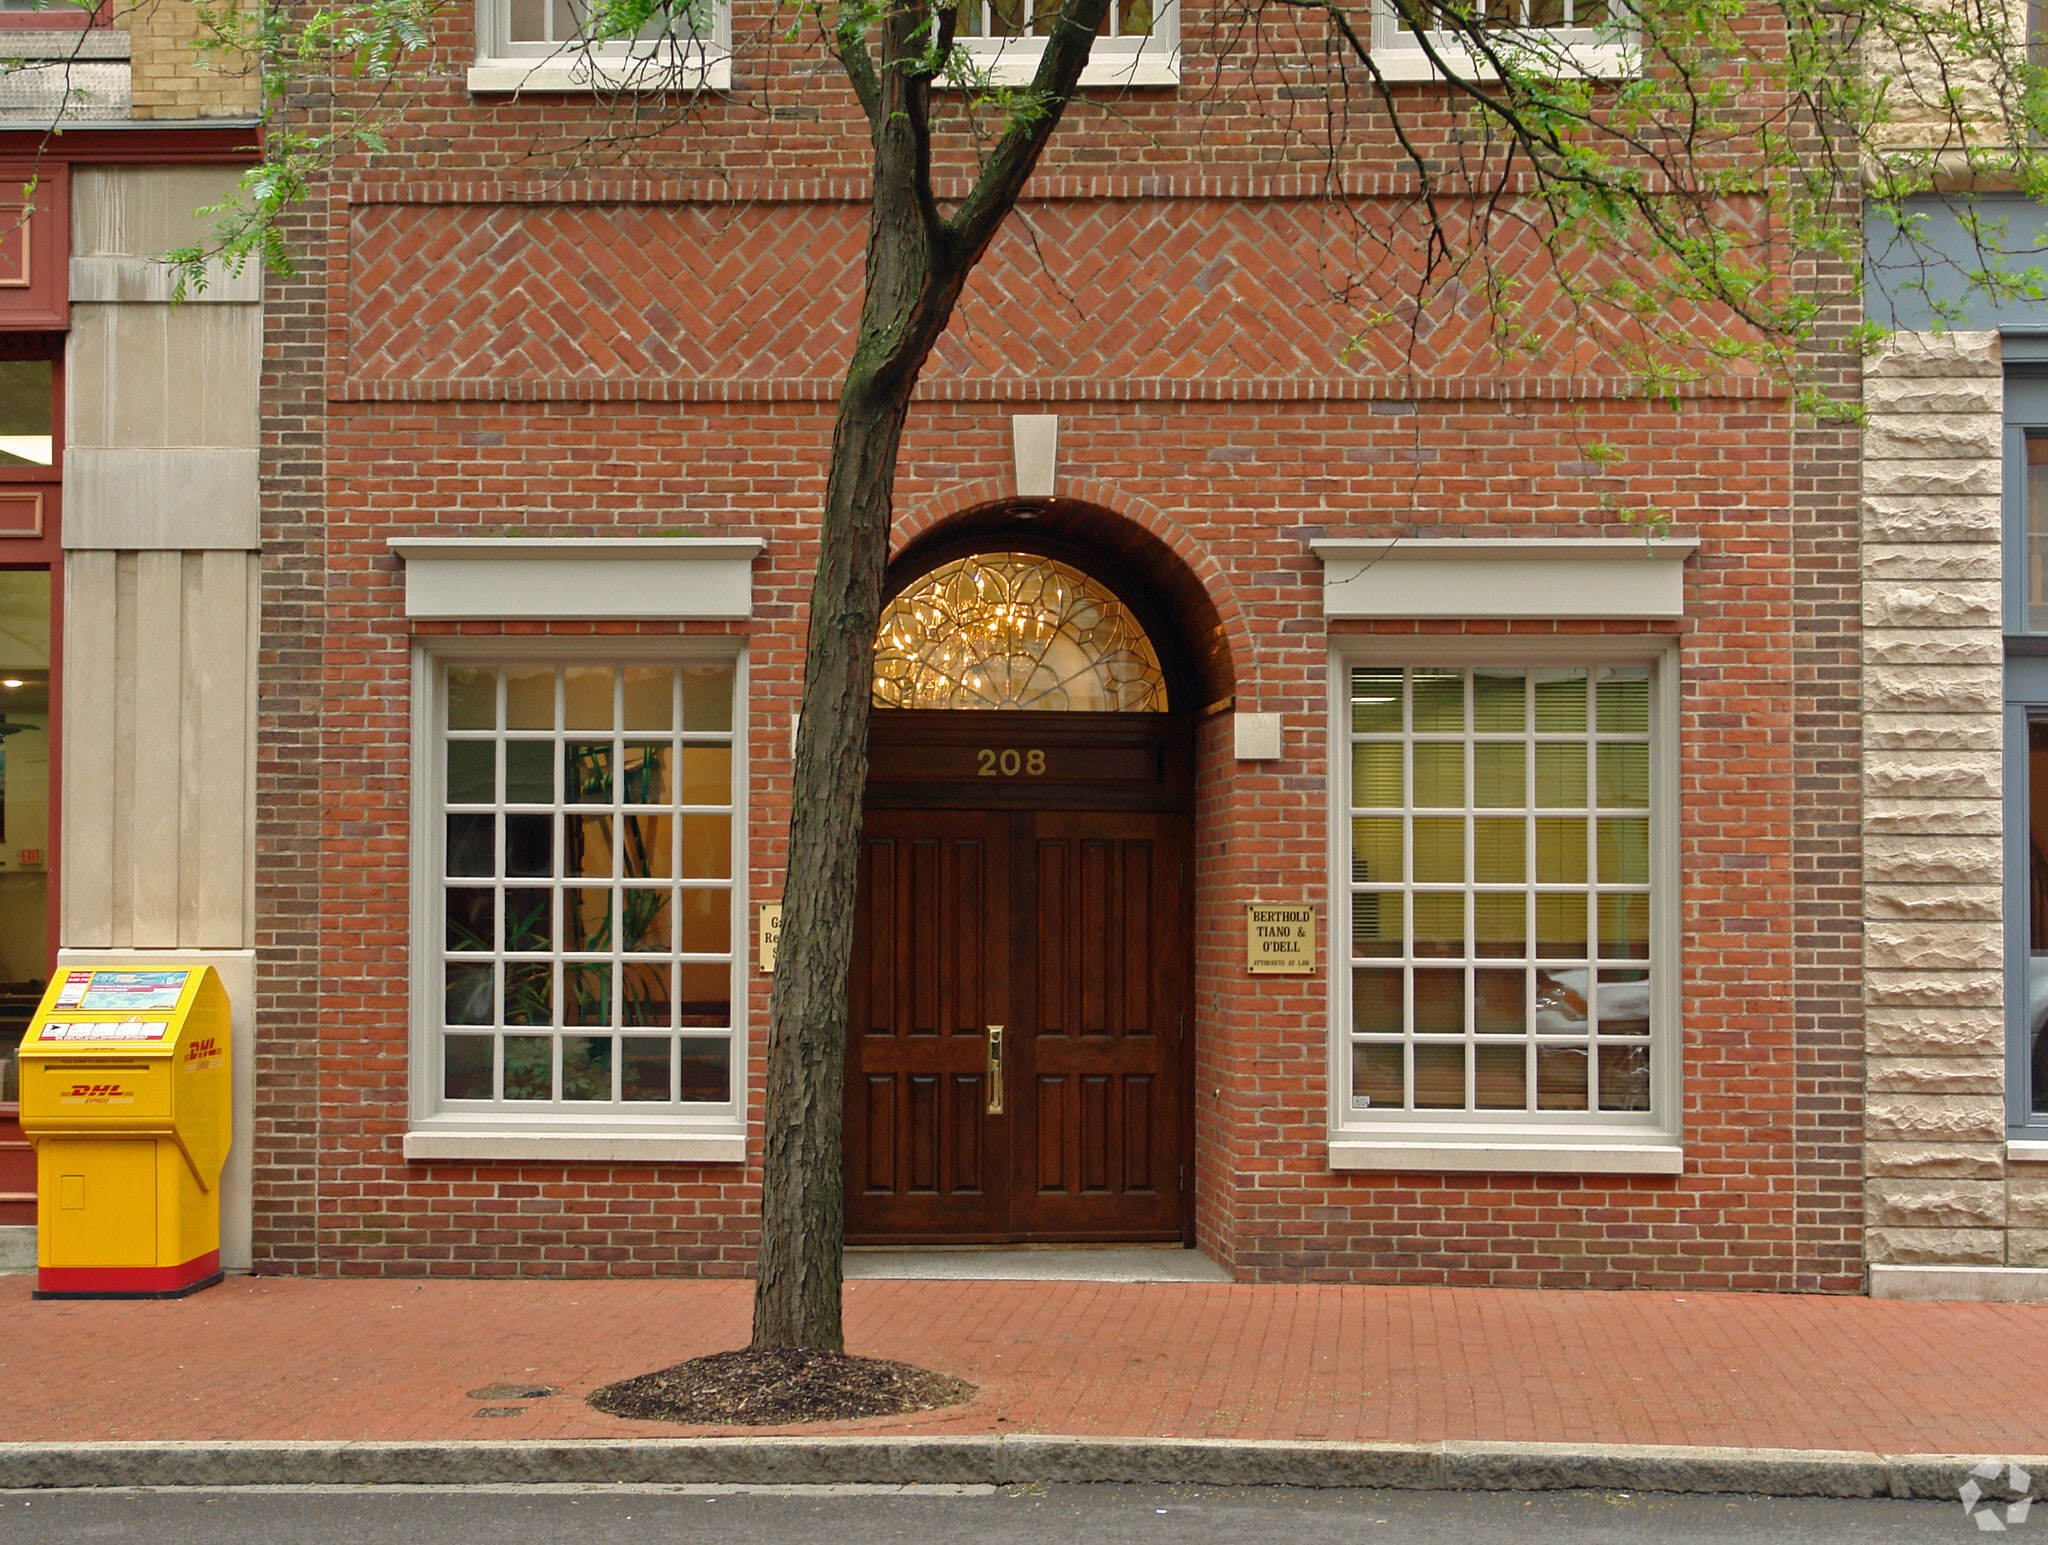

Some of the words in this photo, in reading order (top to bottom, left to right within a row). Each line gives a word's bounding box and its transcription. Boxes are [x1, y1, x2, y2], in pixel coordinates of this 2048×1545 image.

[977, 748, 1047, 776] 208
[21, 848, 40, 863] EXIT
[1253, 911, 1310, 922] BERTHOLD
[1257, 926, 1290, 937] TIANO
[1297, 926, 1306, 937] &
[1263, 941, 1300, 952] O'DELL
[189, 1037, 217, 1060] DHL
[70, 1084, 124, 1097] DHL
